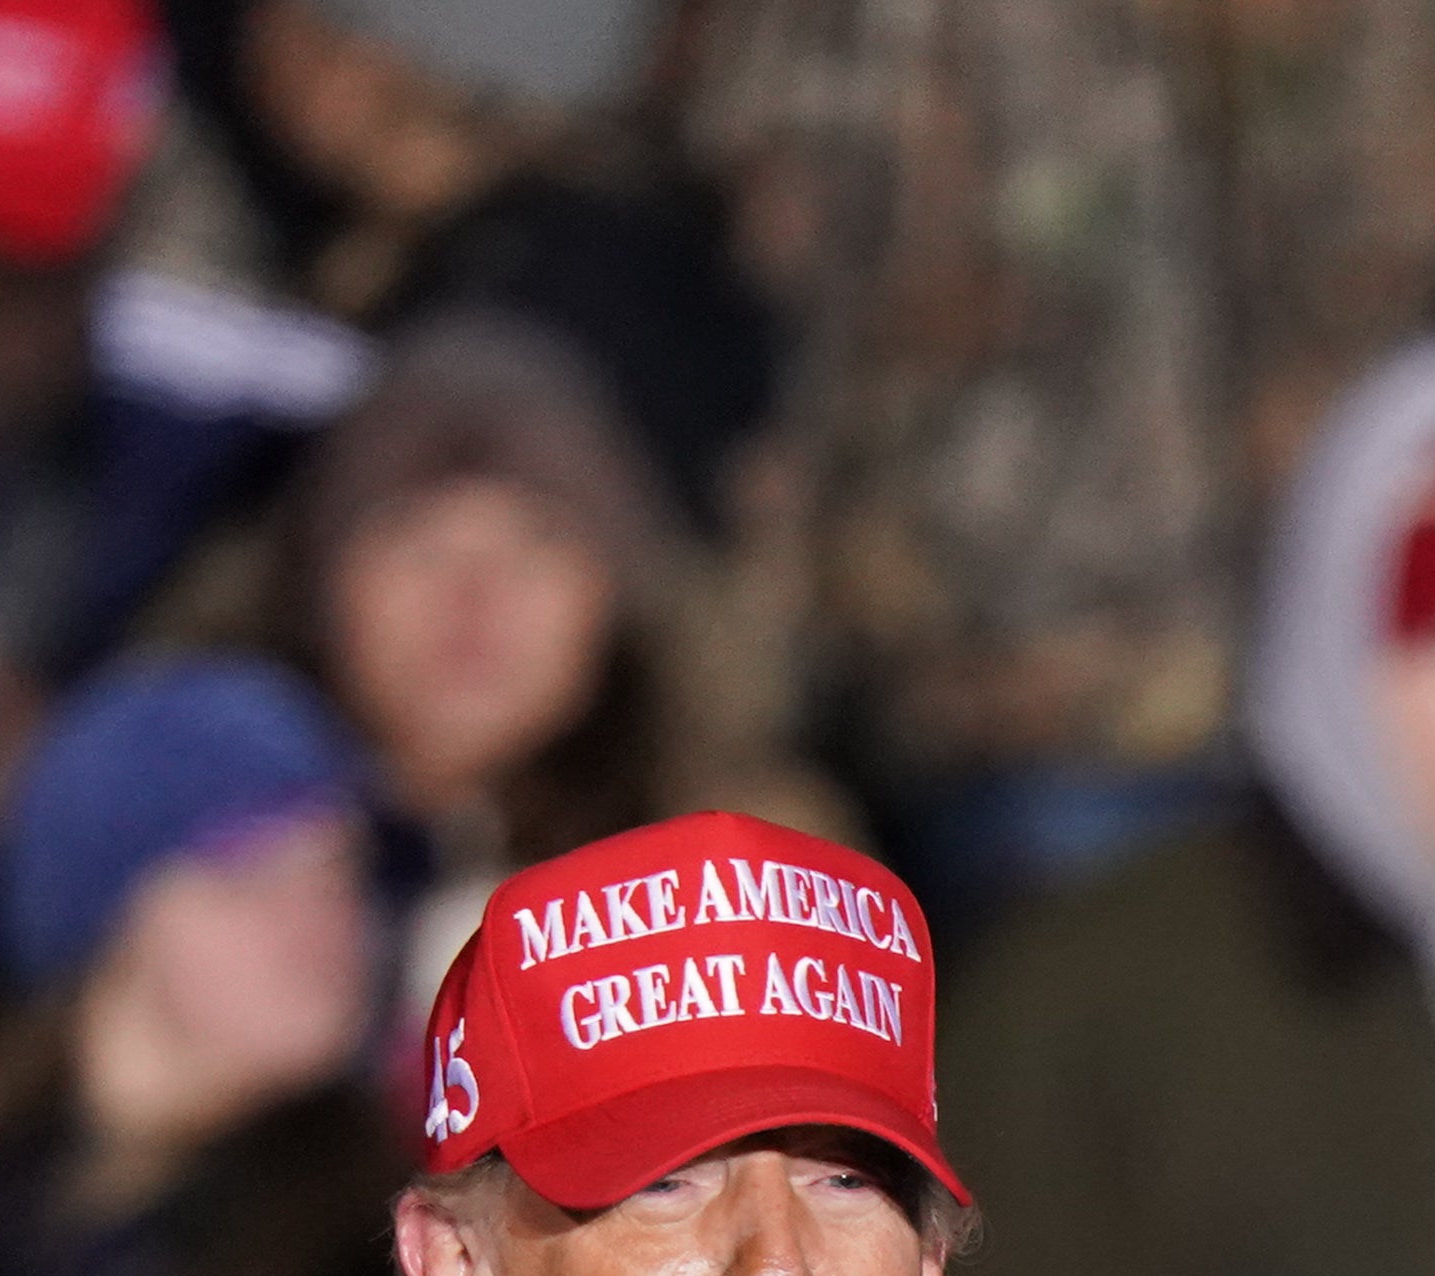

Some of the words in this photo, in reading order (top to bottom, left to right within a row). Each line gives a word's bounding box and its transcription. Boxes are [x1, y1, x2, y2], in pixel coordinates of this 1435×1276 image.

[514, 869, 686, 971] MAKE
[694, 858, 922, 963] AMERICA
[560, 953, 746, 1050] GREAT
[760, 952, 902, 1047] AGAIN
